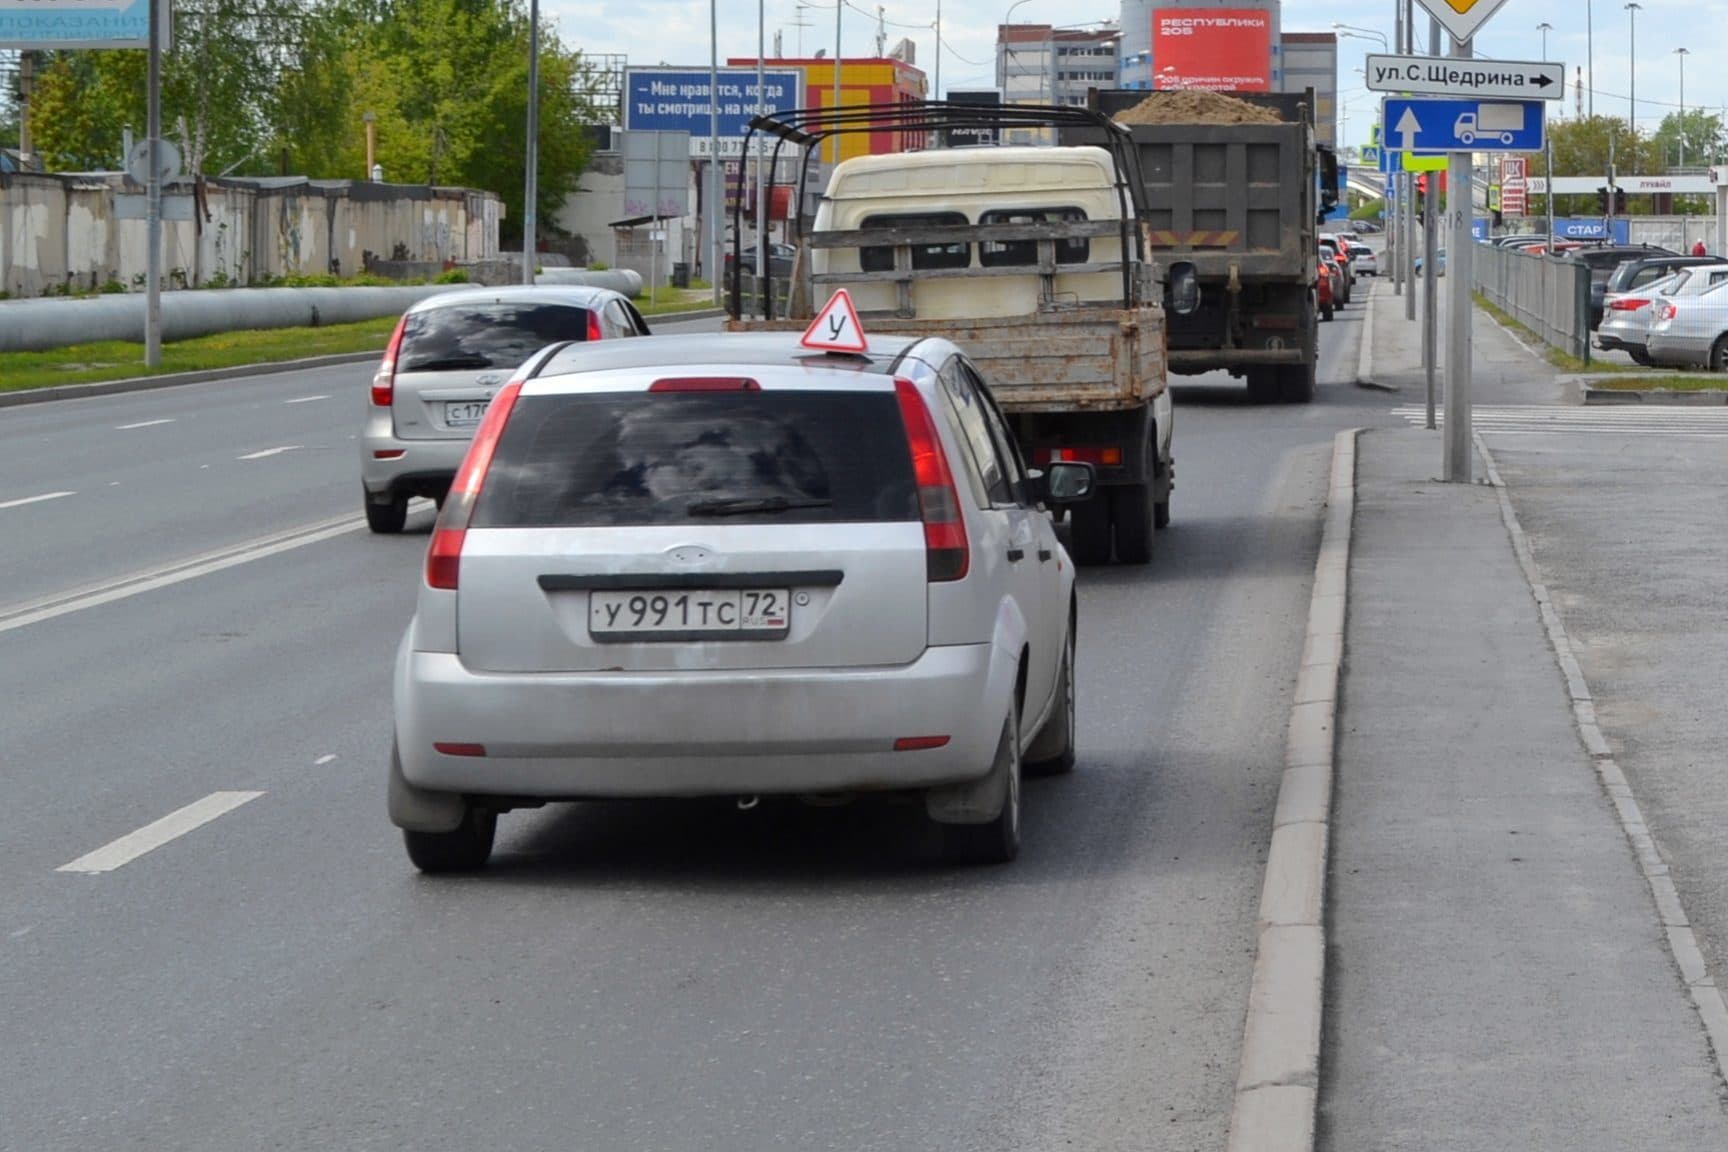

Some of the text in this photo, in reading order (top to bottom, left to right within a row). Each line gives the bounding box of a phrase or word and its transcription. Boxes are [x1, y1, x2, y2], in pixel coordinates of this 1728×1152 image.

[1160, 18, 1265, 28] РЕСПУБЛИКИ
[1160, 27, 1193, 36] 205
[651, 81, 677, 97] Мне
[745, 84, 783, 99] кода
[638, 103, 655, 114] ты
[725, 104, 741, 115] на
[1567, 225, 1606, 236] СТАР
[745, 592, 776, 616] 72
